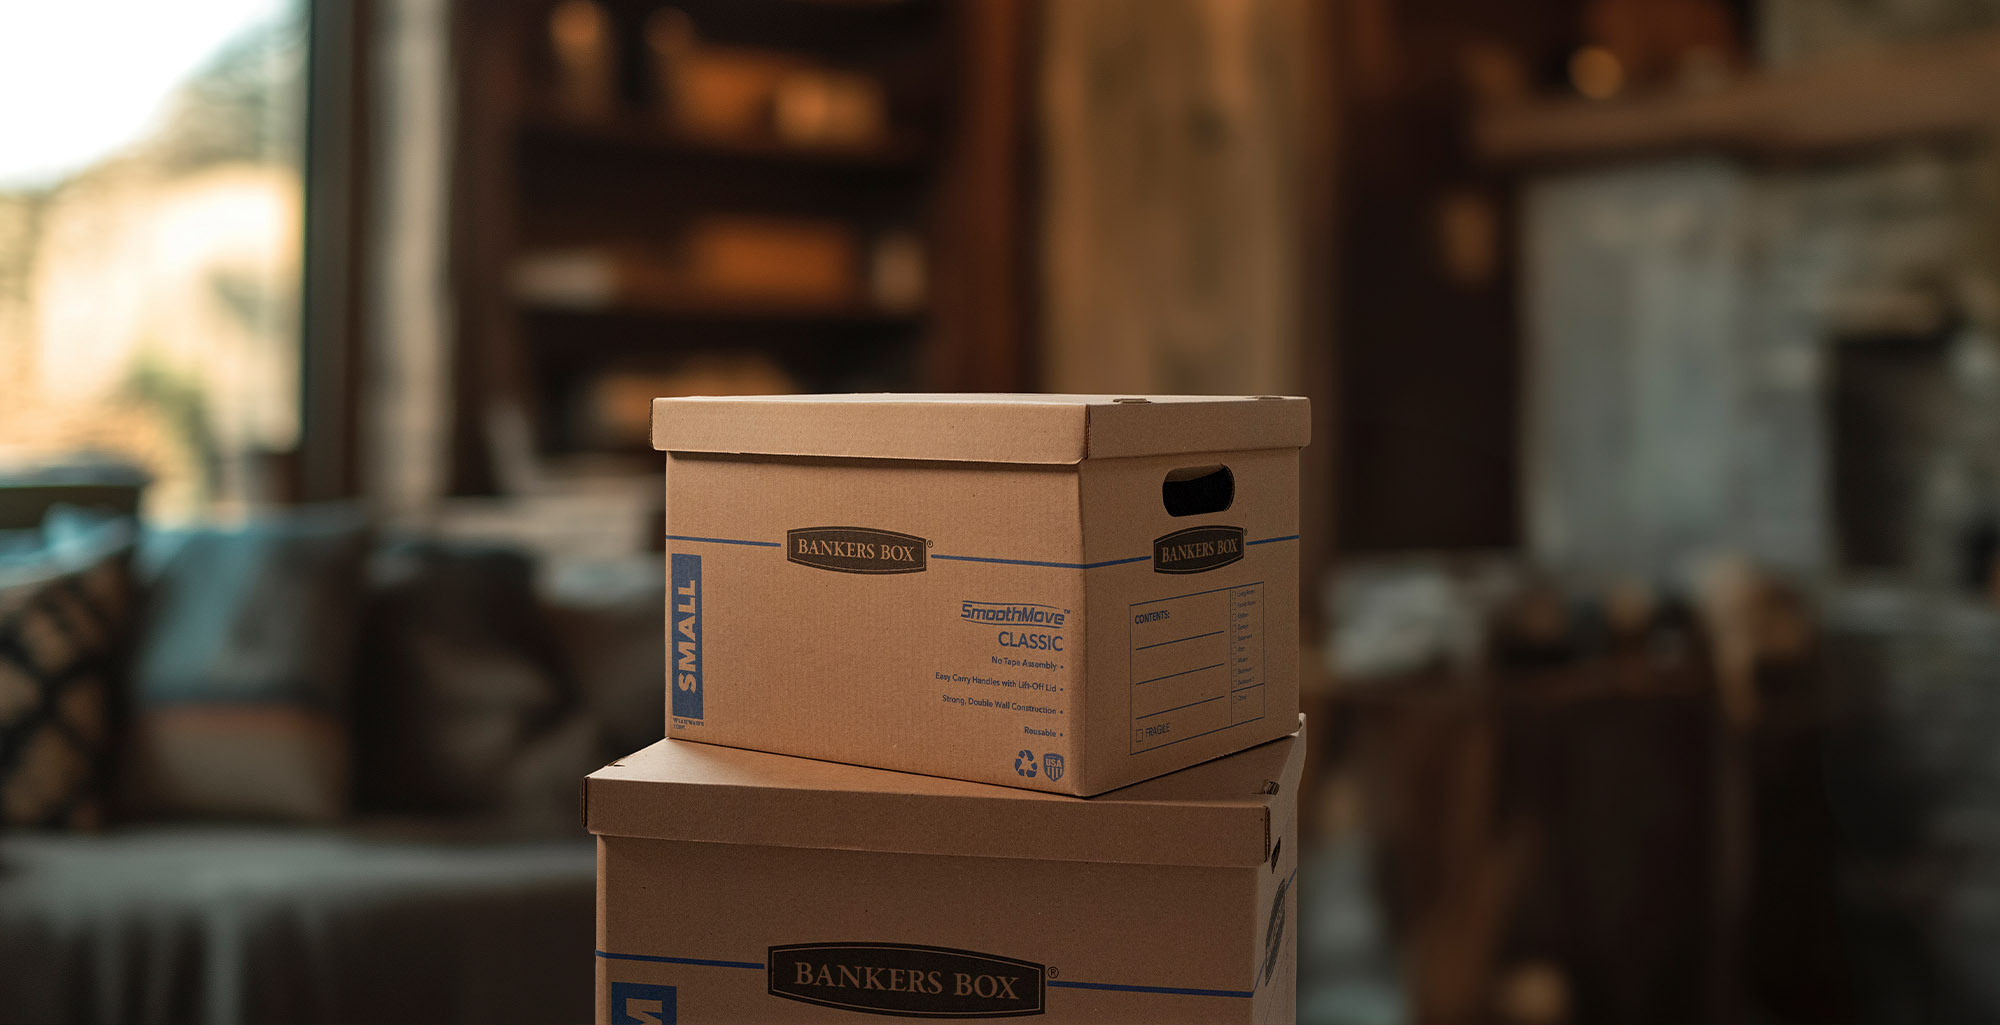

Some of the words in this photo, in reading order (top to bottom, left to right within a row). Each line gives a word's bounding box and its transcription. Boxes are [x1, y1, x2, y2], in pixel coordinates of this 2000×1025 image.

[798, 538, 875, 560] BANKERS
[880, 544, 915, 562] BOX
[1161, 541, 1214, 563] BANKERS
[1217, 538, 1238, 553] BOX
[961, 603, 1065, 625] SmoothMove
[1135, 609, 1170, 624] CONTENTS:
[678, 579, 697, 694] SMALL
[998, 631, 1064, 651] CLASSIC
[991, 656, 1003, 664] No
[1004, 657, 1021, 667] Tape
[1022, 659, 1057, 671] Assembly
[935, 672, 951, 682] Easy
[952, 674, 971, 685] Carry
[972, 676, 1001, 687] Handles
[1001, 680, 1017, 688] with
[1018, 680, 1044, 691] Lift-Off
[1045, 683, 1057, 692] Lid
[968, 697, 993, 708] Double
[994, 700, 1010, 709] Wall
[1011, 703, 1057, 715] Construction
[1024, 726, 1057, 737] Reusable
[1145, 722, 1170, 737] FRAGILE
[1046, 757, 1063, 768] USA
[794, 961, 943, 994] BANKERS
[954, 974, 1020, 1000] BOX
